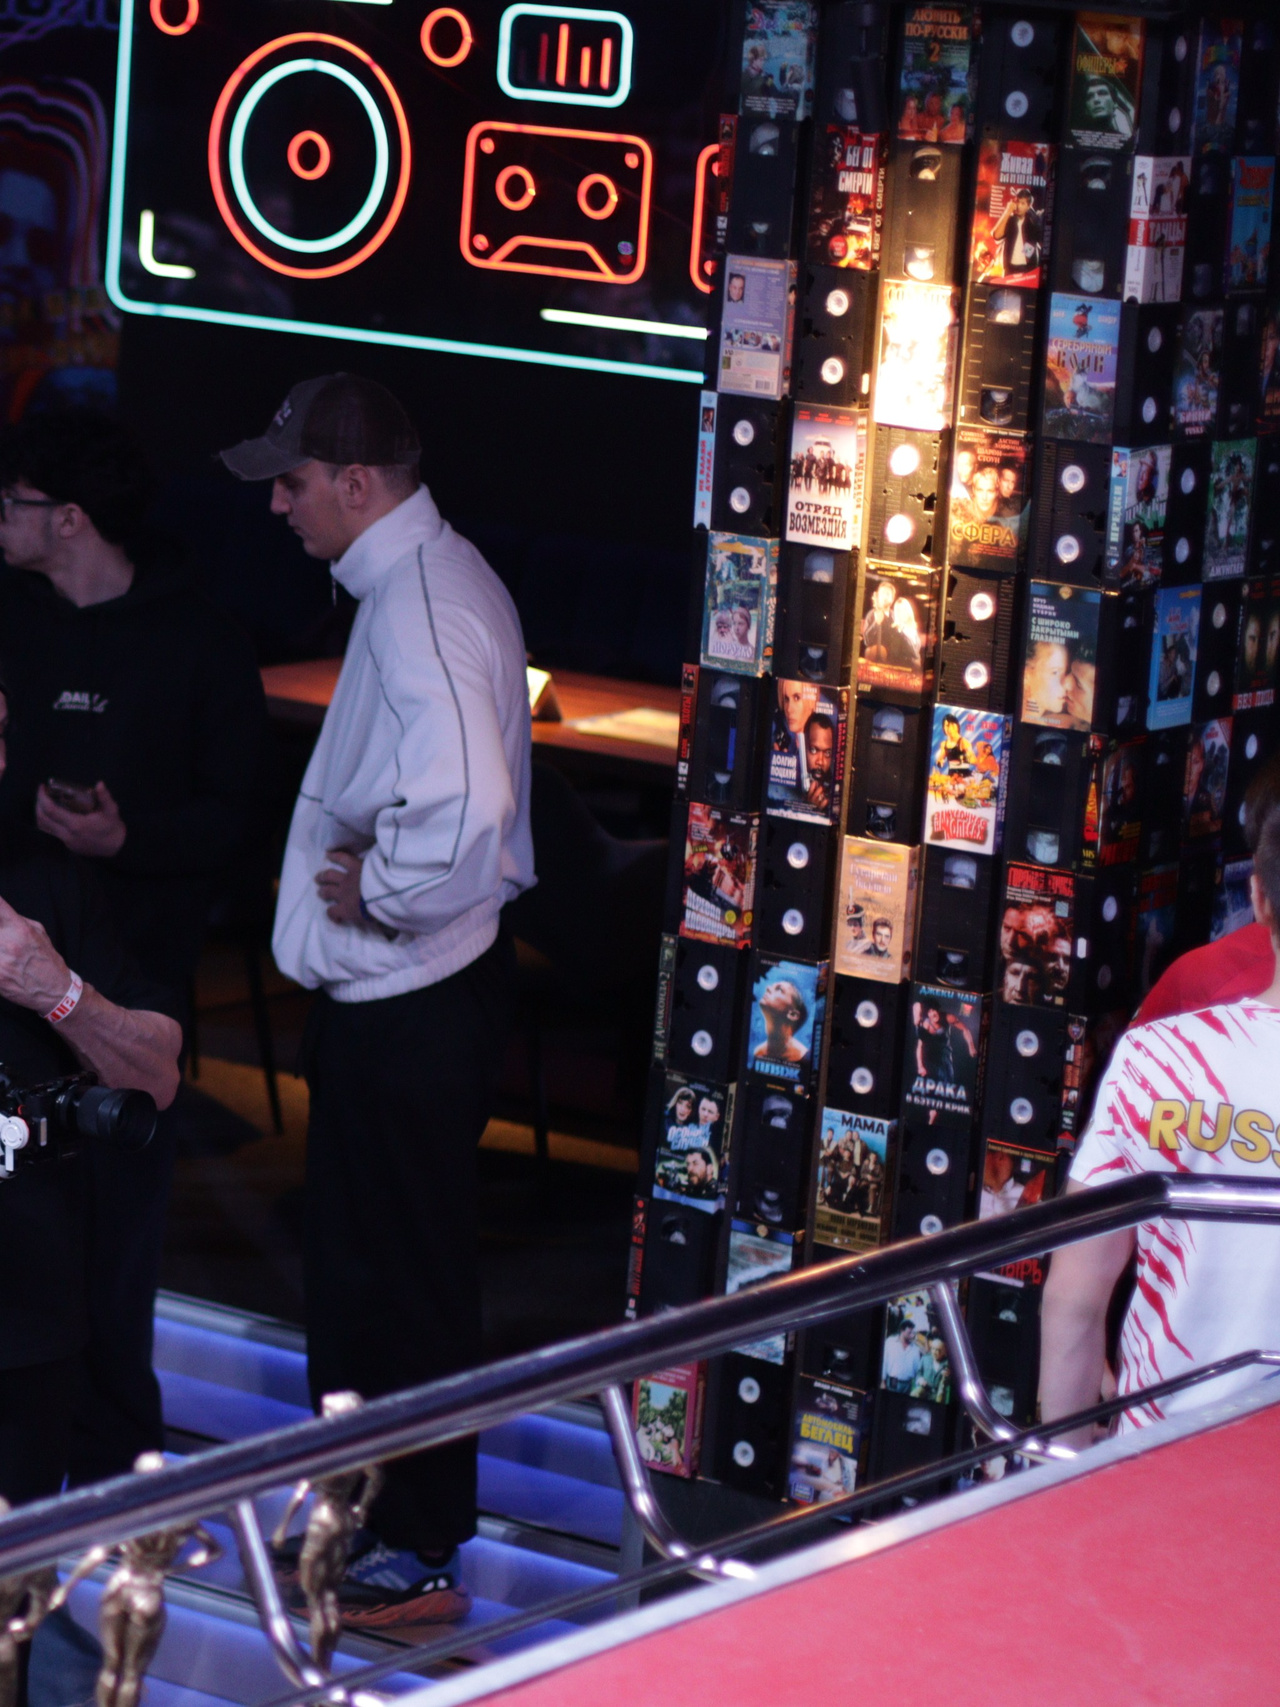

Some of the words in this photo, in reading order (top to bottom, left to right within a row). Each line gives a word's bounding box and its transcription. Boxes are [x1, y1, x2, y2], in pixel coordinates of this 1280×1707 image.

[912, 8, 962, 24] ЛЮБИТЬ
[905, 22, 969, 41] ПО-РУССКИ
[929, 41, 940, 62] 2
[846, 146, 860, 168] БЕГ
[862, 147, 874, 169] ОТ
[838, 170, 873, 196] СМЕРТИ
[877, 167, 885, 210] СМЕРТИ
[977, 455, 1001, 464] СТОУН
[795, 501, 843, 516] ОТРЯД
[789, 511, 848, 539] ВОЗМЕЗДИЯ
[952, 521, 1017, 548] СФЕРА
[1031, 624, 1080, 640] ЗАКРЫТЫМИ
[1038, 618, 1071, 630] ШИРОКО
[1031, 633, 1066, 645] ГЛАЗАМИ
[772, 753, 797, 768] ДОЛГИЙ
[770, 765, 797, 781] ПОЦЕЛУЙ
[919, 985, 955, 999] ДЖЕКИ
[957, 992, 978, 1003] ЧАН
[754, 1059, 801, 1080] ПЛЯЖ
[912, 1076, 967, 1101] ДРАКА
[905, 1093, 912, 1102] В
[913, 1095, 944, 1109] БЭТТЛ
[945, 1102, 972, 1114] КРИК
[841, 1113, 886, 1136] МАМА
[1148, 1098, 1280, 1169] RUS
[800, 1423, 854, 1454] БЕГЛЕЦ
